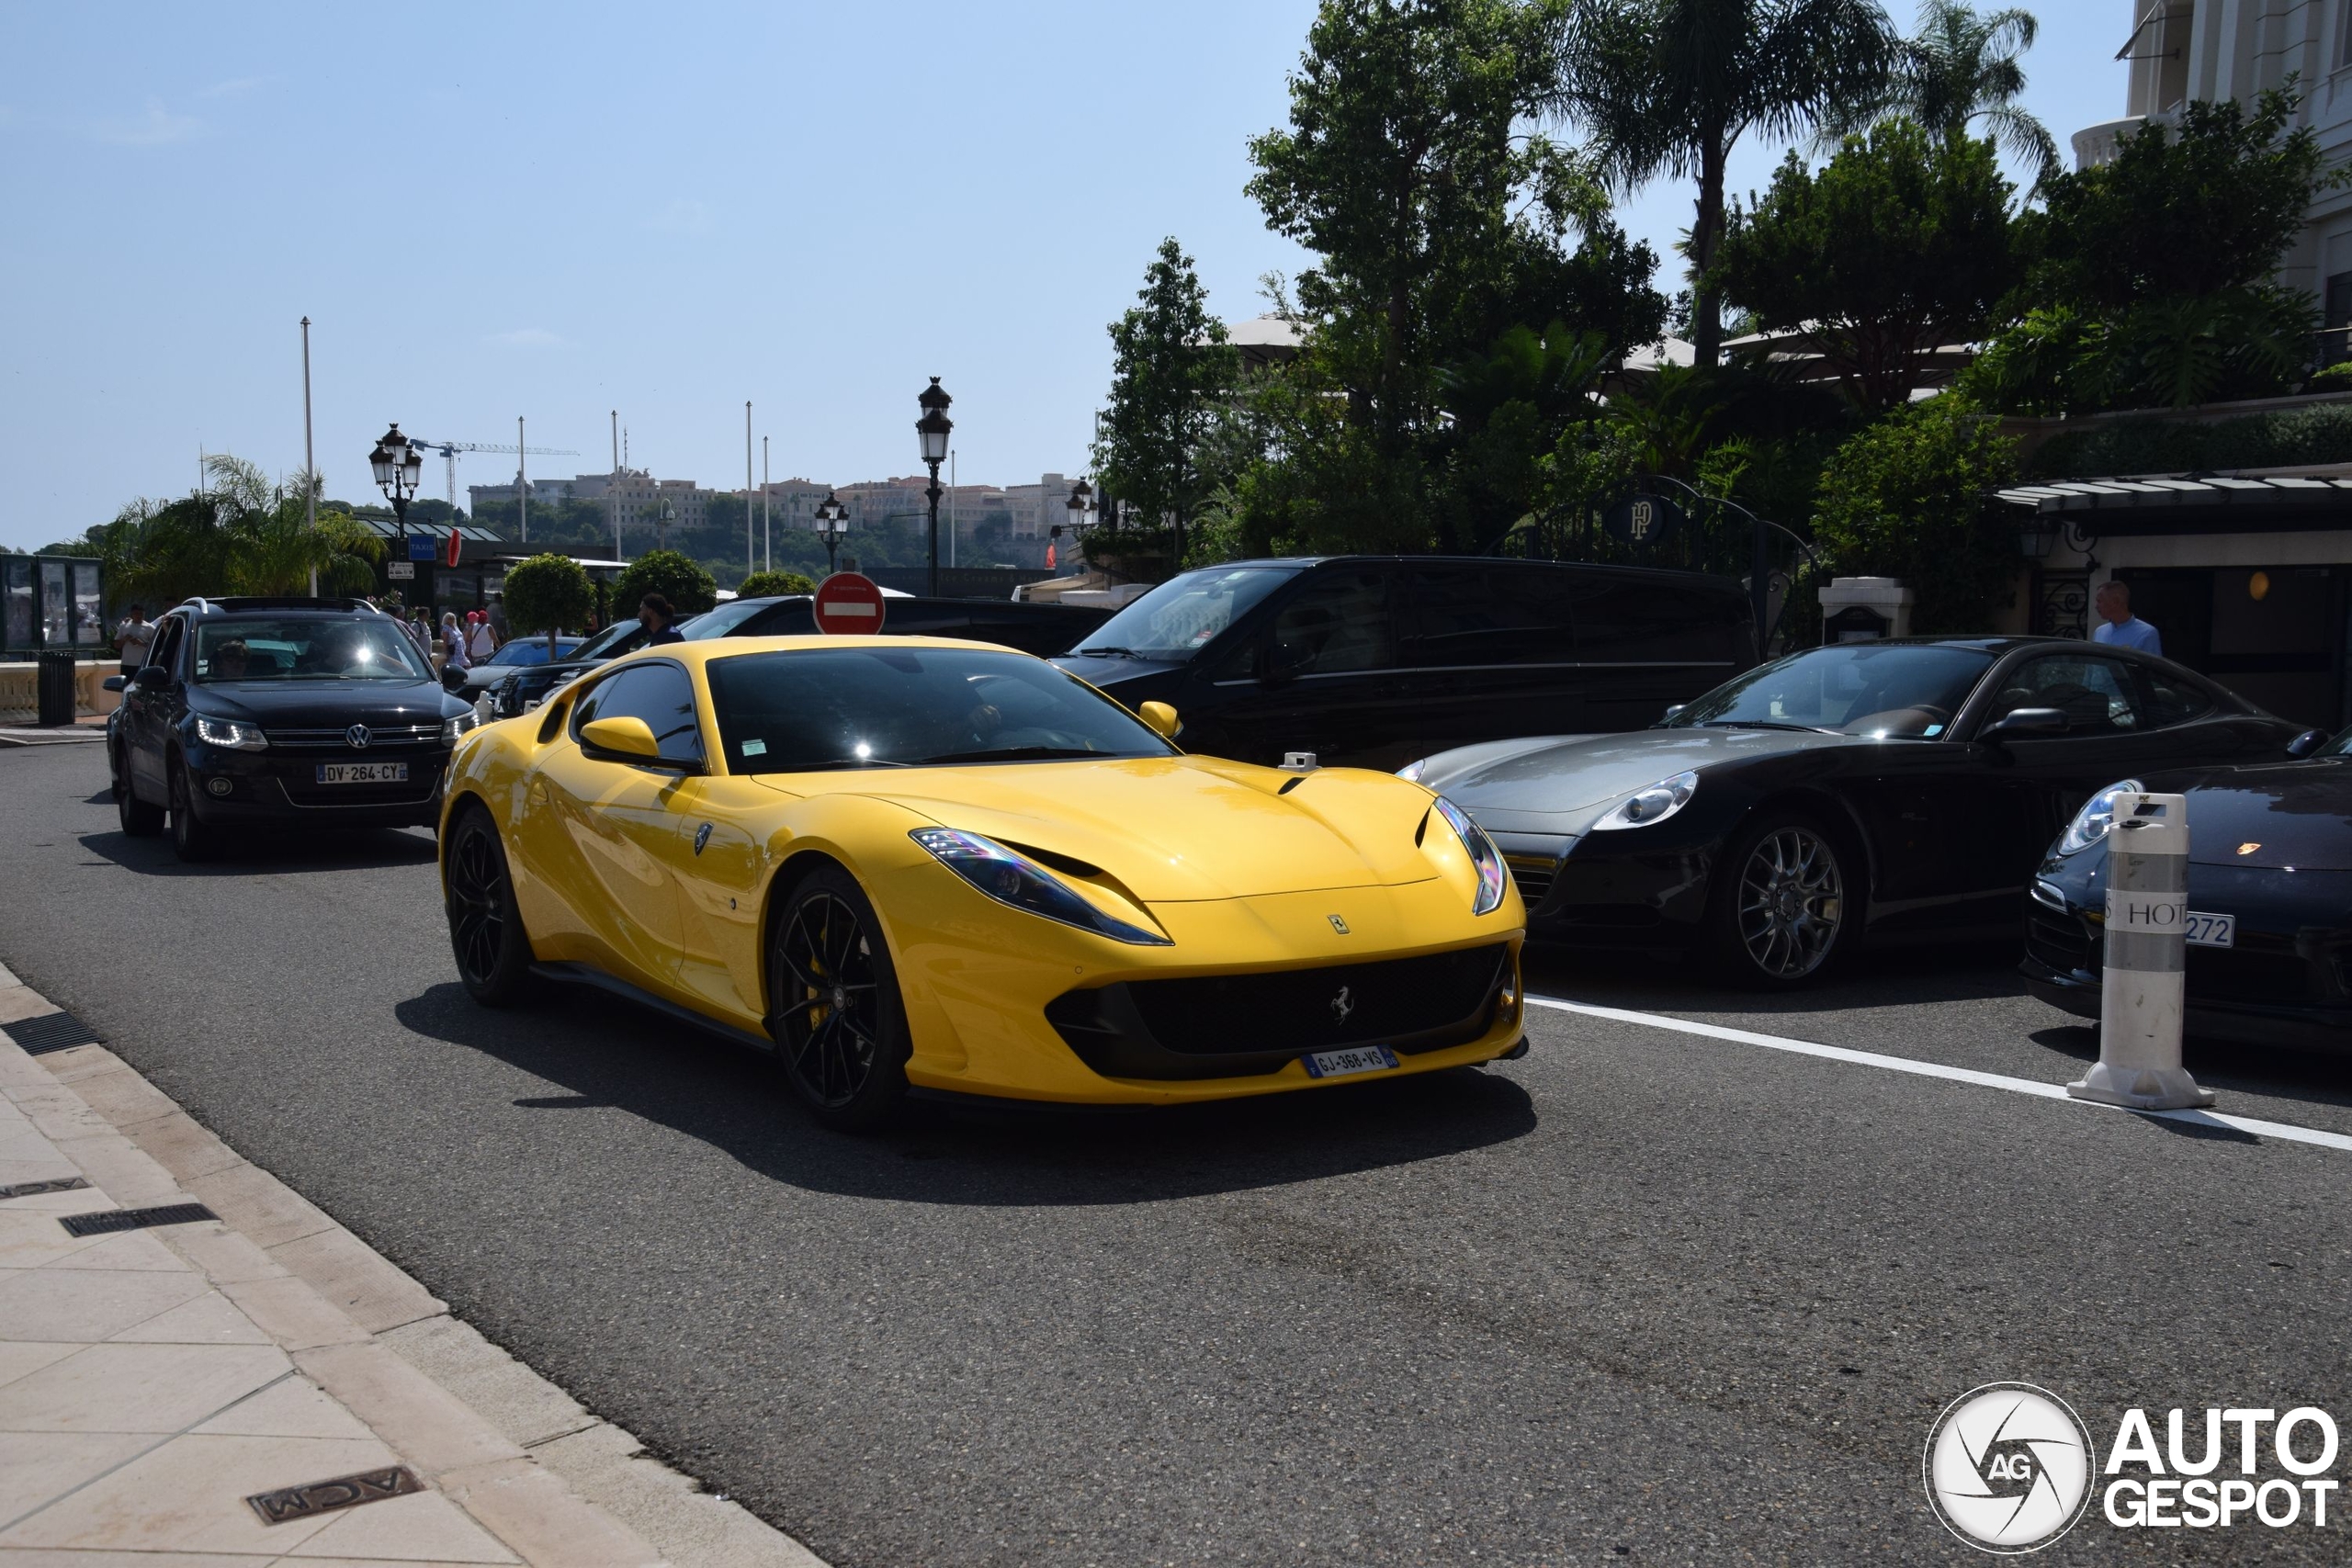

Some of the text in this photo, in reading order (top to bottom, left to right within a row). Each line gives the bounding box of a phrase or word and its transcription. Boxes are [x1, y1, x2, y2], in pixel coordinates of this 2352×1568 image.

[327, 765, 398, 782] DV-264-CY
[2130, 902, 2187, 925] HOT
[1317, 1050, 1383, 1072] GJ-368-VS
[1385, 1056, 1397, 1066] 06
[264, 1471, 401, 1515] ACM
